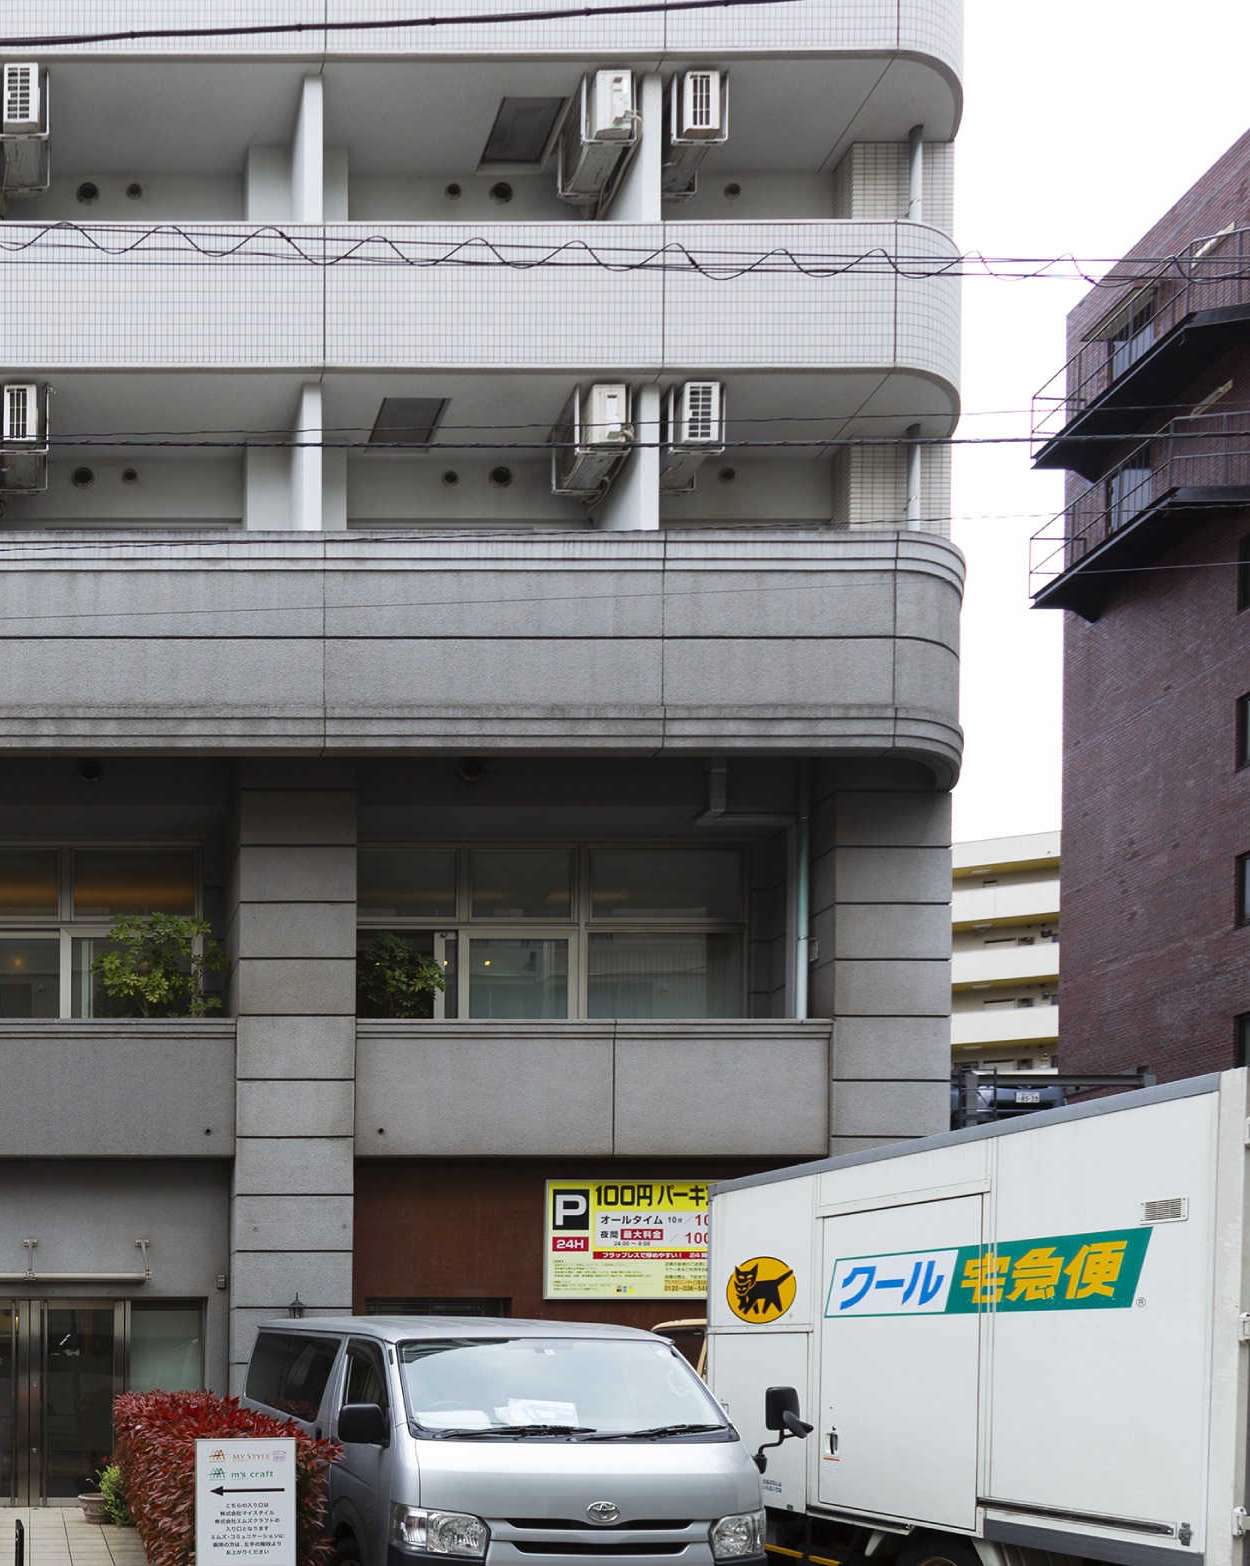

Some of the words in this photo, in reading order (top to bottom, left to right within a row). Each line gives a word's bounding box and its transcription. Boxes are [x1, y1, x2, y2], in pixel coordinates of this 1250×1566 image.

[555, 1194, 587, 1226] P
[600, 1215, 663, 1225] オールタイム
[600, 1230, 619, 1239] 夜間
[623, 1230, 662, 1239] 最大料金
[556, 1239, 585, 1249] 24H
[839, 1260, 945, 1311] クール
[960, 1240, 1128, 1304] 宅急便
[231, 1470, 246, 1478] m's
[250, 1470, 274, 1478] craft
